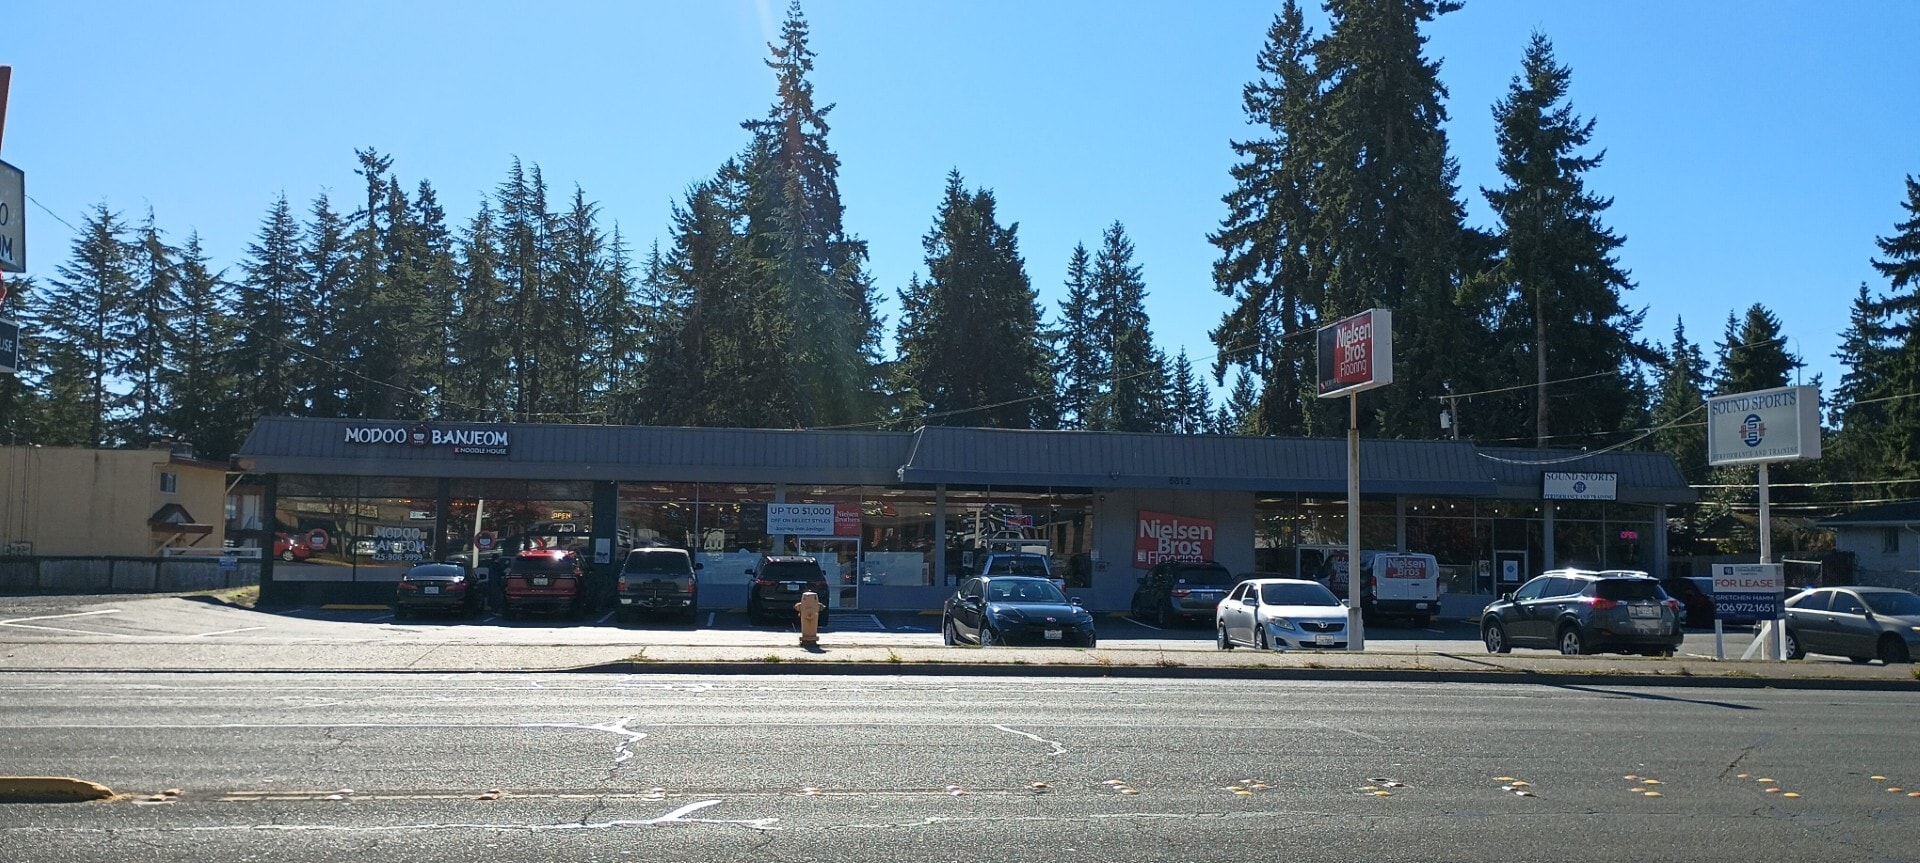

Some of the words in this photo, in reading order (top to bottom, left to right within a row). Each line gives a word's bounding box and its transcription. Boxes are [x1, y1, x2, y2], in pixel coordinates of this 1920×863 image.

[1336, 322, 1371, 348] Nielsen
[1344, 343, 1366, 363] Bros
[1340, 359, 1367, 377] Flooring
[1712, 398, 1750, 415] SOUND
[1751, 391, 1796, 410] SPORTS
[344, 427, 407, 443] MODOO
[432, 429, 508, 446] BANJEOM
[1545, 473, 1578, 481] SOUND
[1580, 473, 1615, 481] SPORTS
[770, 507, 784, 515] UP
[786, 507, 799, 515] TO
[802, 507, 831, 516] $1,000
[374, 526, 420, 539] MODOO
[1140, 519, 1213, 540] Nielsen
[1620, 531, 1638, 539] OPEN
[1158, 537, 1201, 555] Bros
[1387, 557, 1425, 569] Nielsen
[1397, 567, 1420, 576] Bros
[1715, 579, 1737, 588] FOR
[1739, 579, 1774, 588] LEASE
[1716, 603, 1775, 612] 206.972.1651
